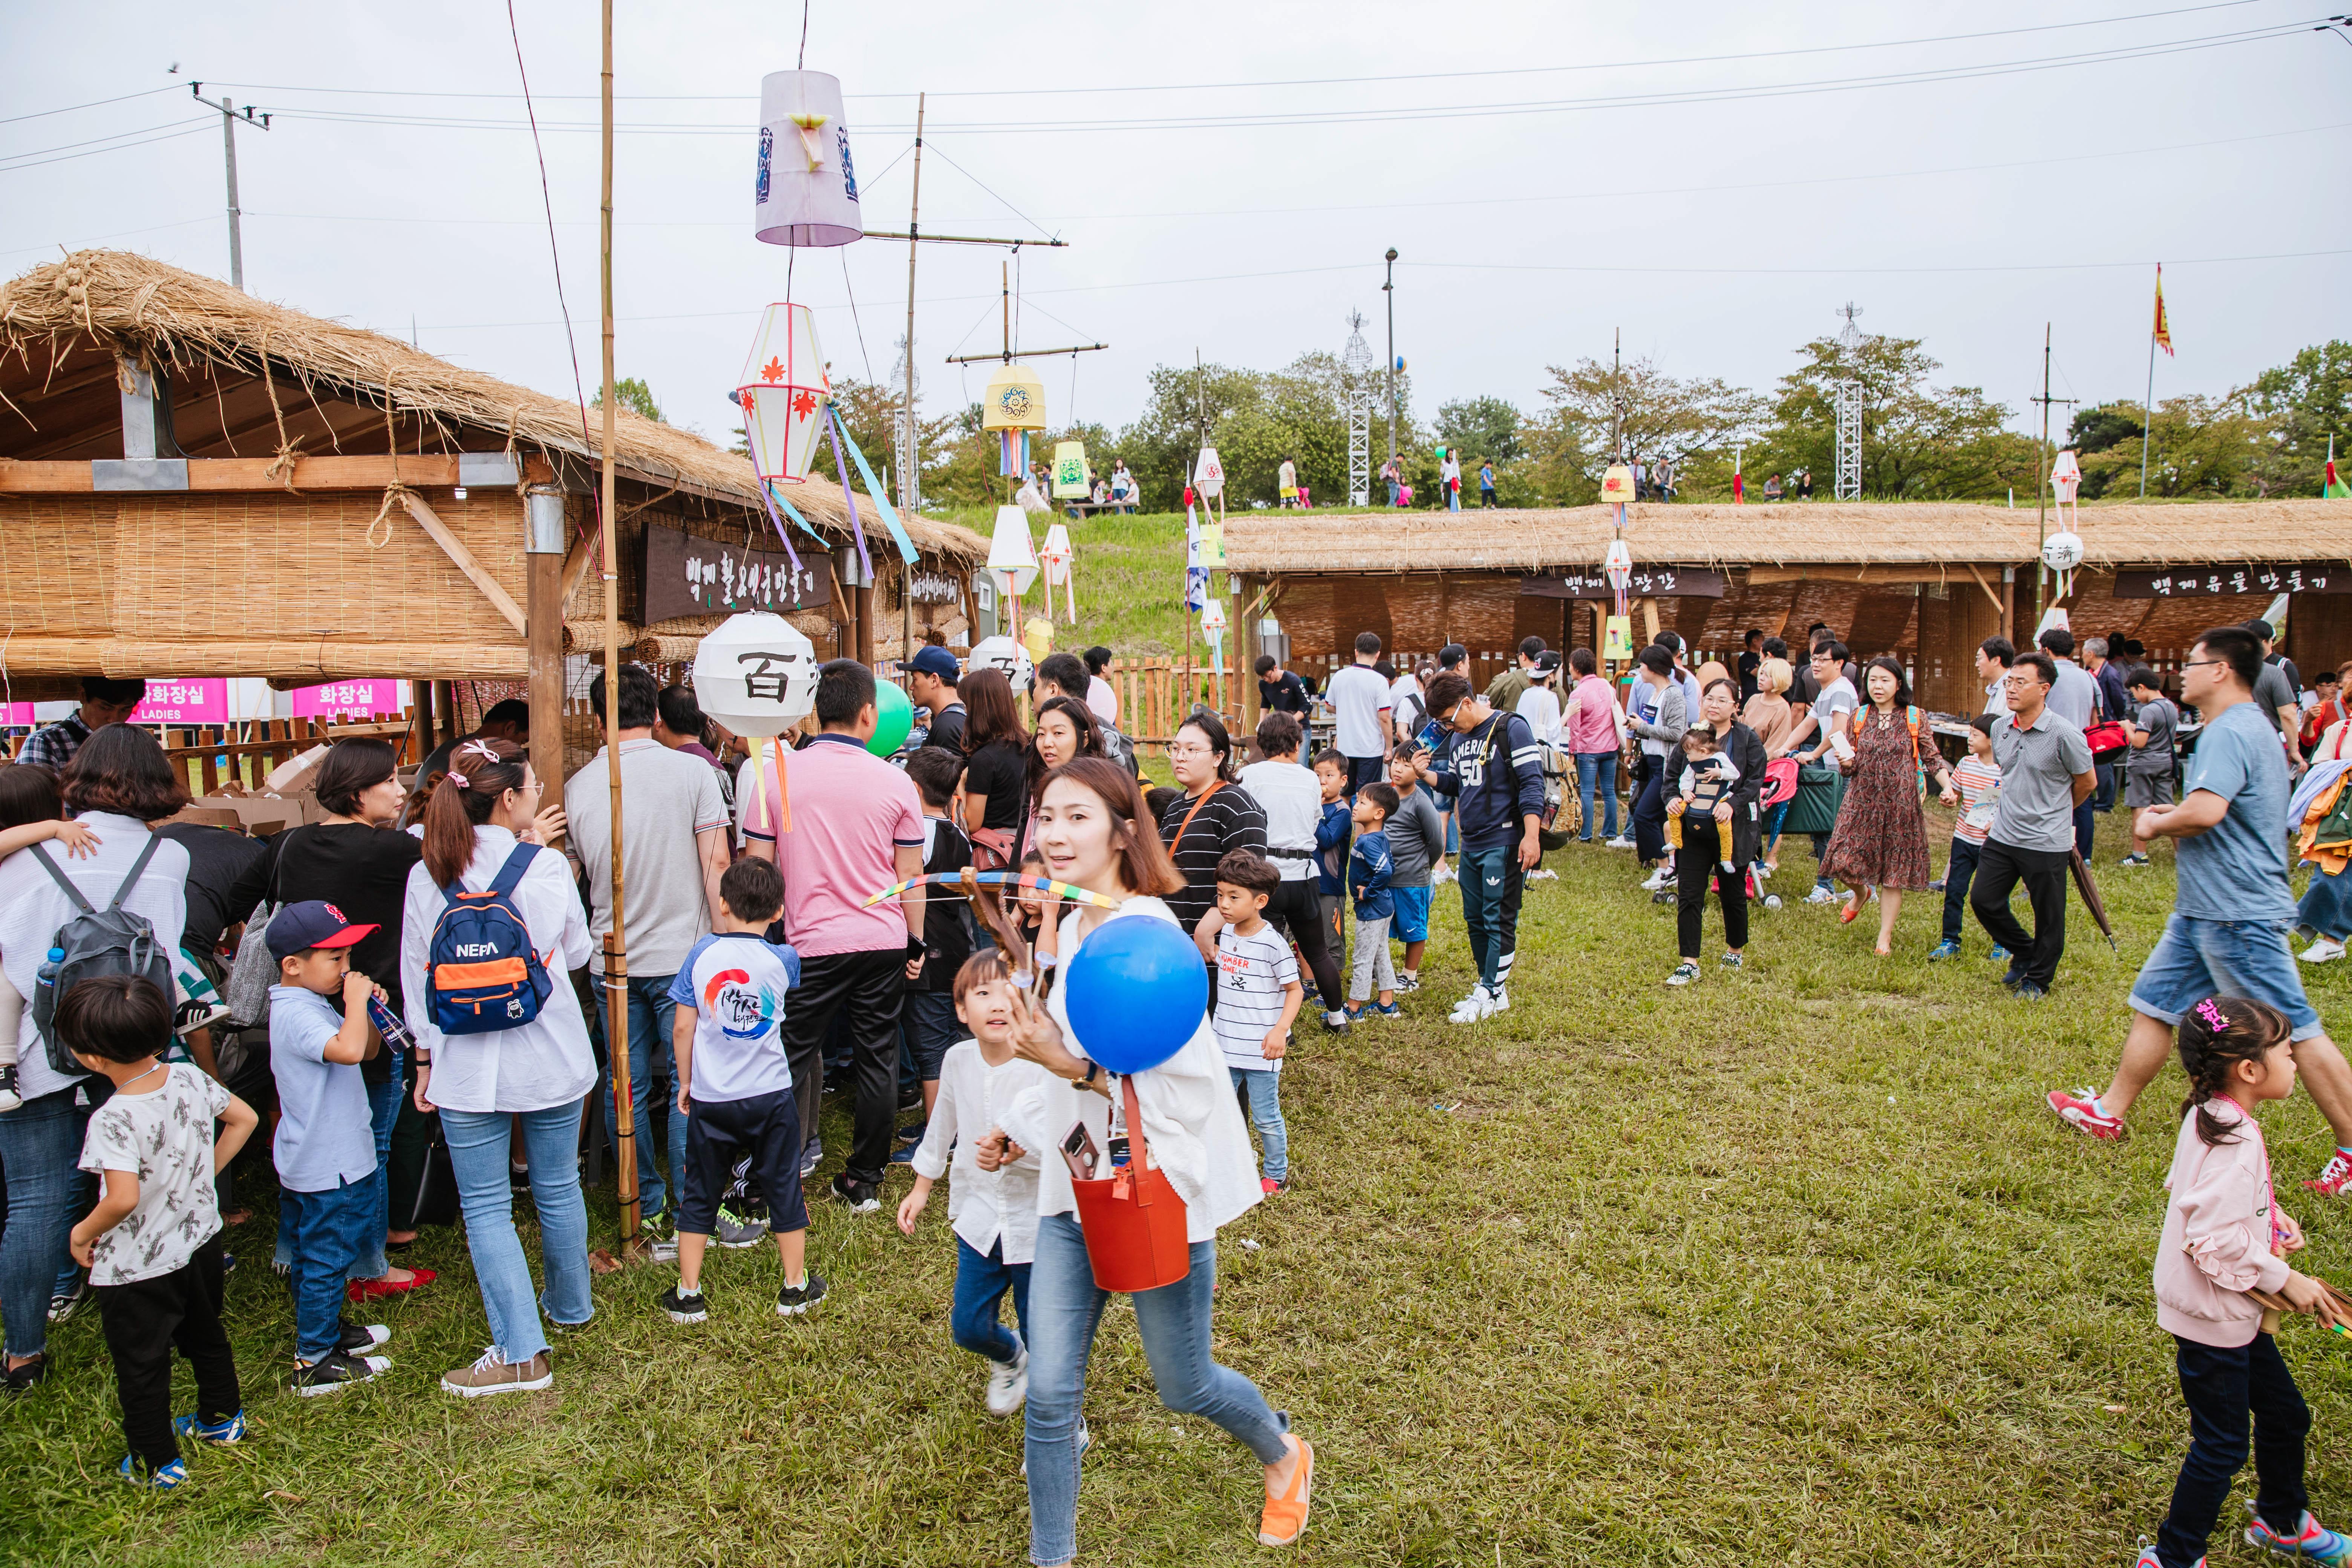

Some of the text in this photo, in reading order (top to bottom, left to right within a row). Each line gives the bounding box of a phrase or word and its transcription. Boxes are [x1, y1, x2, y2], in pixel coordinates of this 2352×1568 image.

[320, 684, 373, 704] 화장실
[142, 709, 181, 720] LADIES
[328, 707, 368, 717] LADIES
[1459, 758, 1483, 787] 50
[456, 942, 499, 957] NEPA
[1221, 954, 1249, 969] NUMBER
[52, 1299, 64, 1308] NIKE
